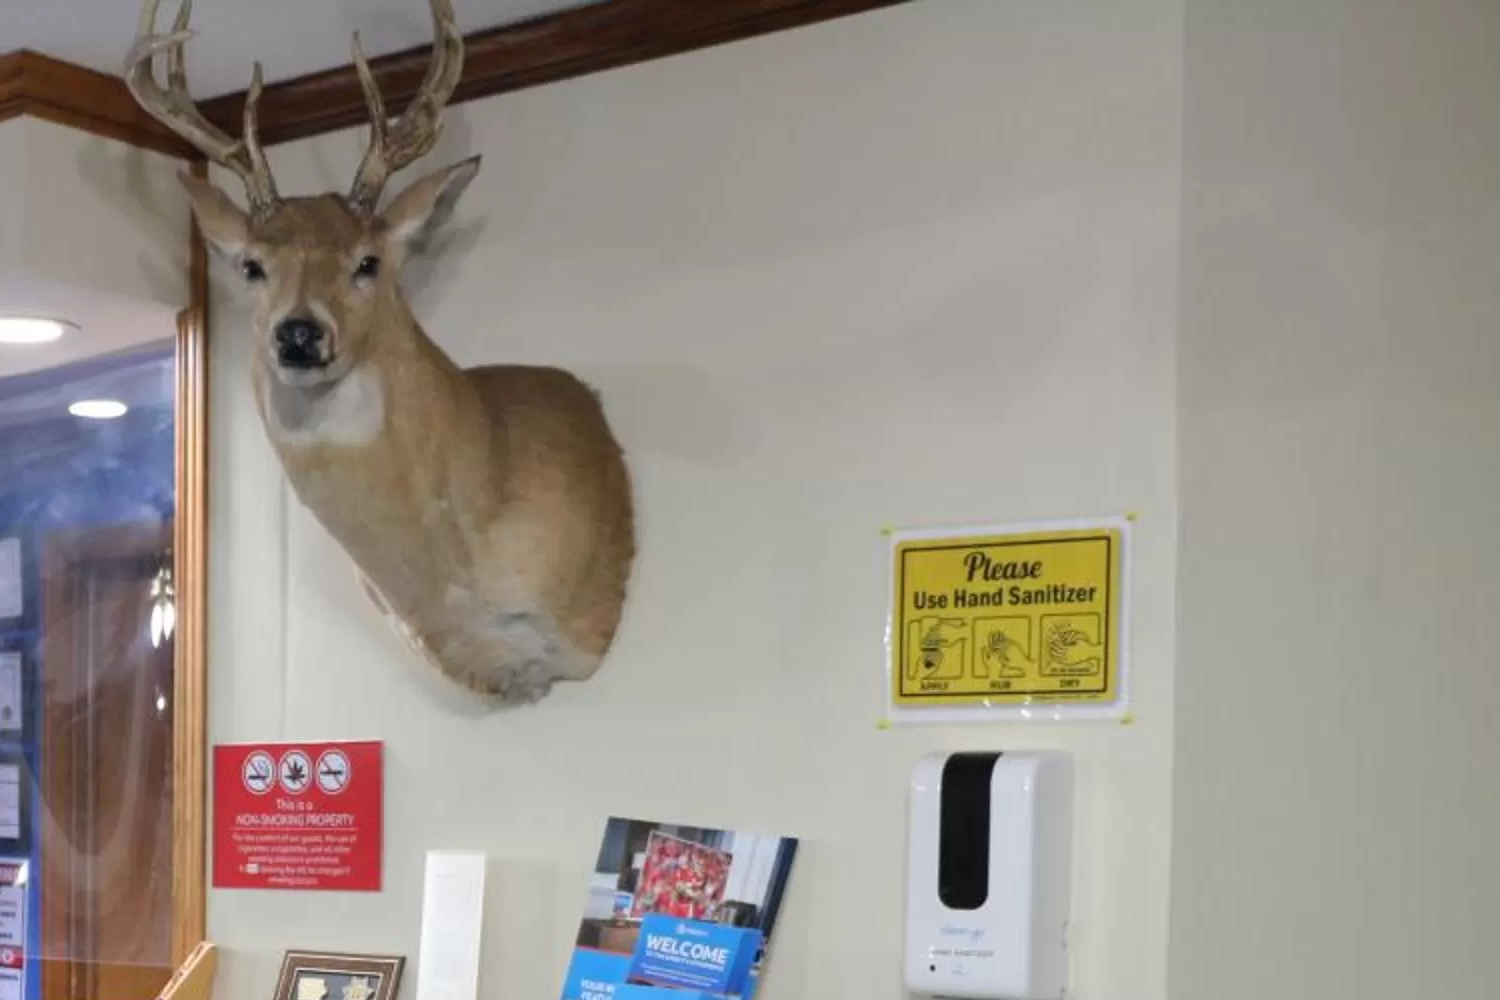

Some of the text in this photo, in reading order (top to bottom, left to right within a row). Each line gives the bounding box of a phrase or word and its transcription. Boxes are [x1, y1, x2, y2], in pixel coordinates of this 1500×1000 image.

[963, 551, 1042, 582] Please
[913, 583, 1097, 610] Use Hand Sanitizer
[276, 798, 295, 811] This
[235, 812, 356, 827] NON-SMOKING PROPERTY
[646, 932, 731, 966] WELCOME
